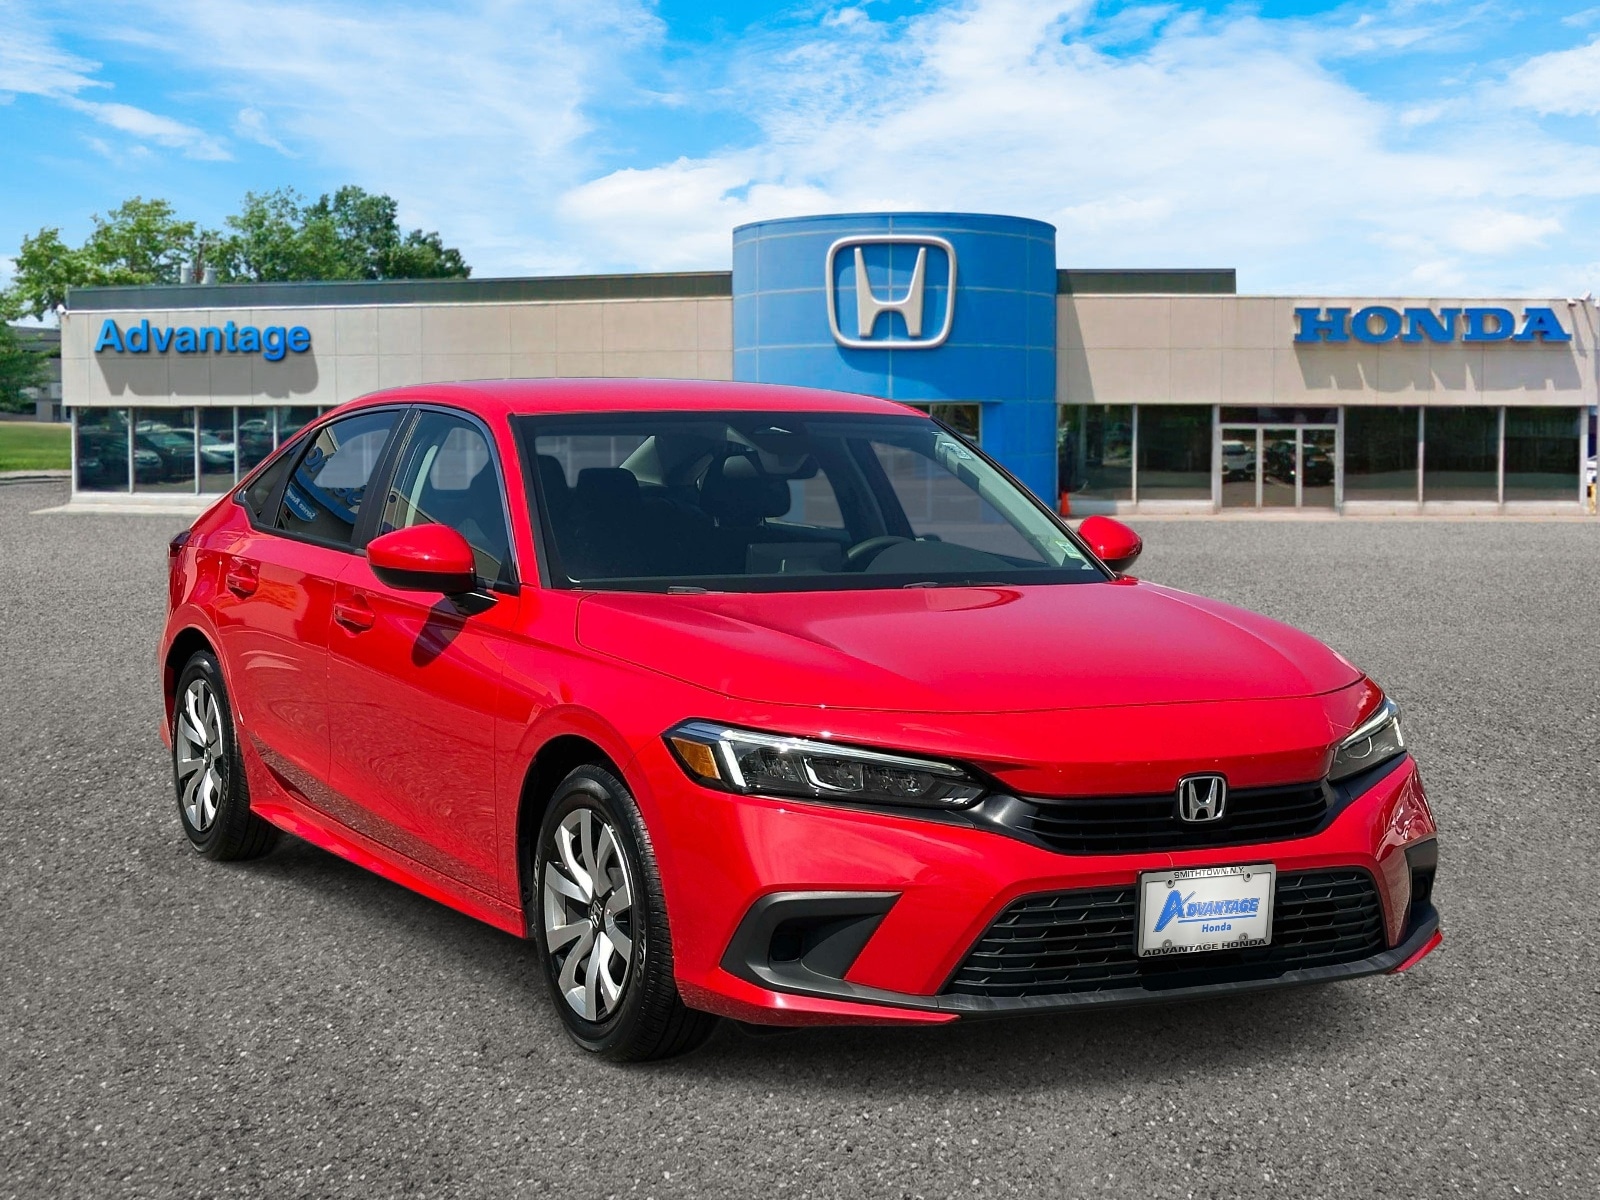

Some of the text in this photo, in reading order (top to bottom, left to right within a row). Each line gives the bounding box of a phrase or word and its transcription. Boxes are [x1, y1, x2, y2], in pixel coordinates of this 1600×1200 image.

[94, 319, 311, 361] Advantage
[1294, 306, 1572, 343] HONDA
[1153, 890, 1260, 932] ADVANTAGE
[1202, 922, 1232, 933] Honda
[1142, 938, 1267, 957] ADVANTAGE HONDA
